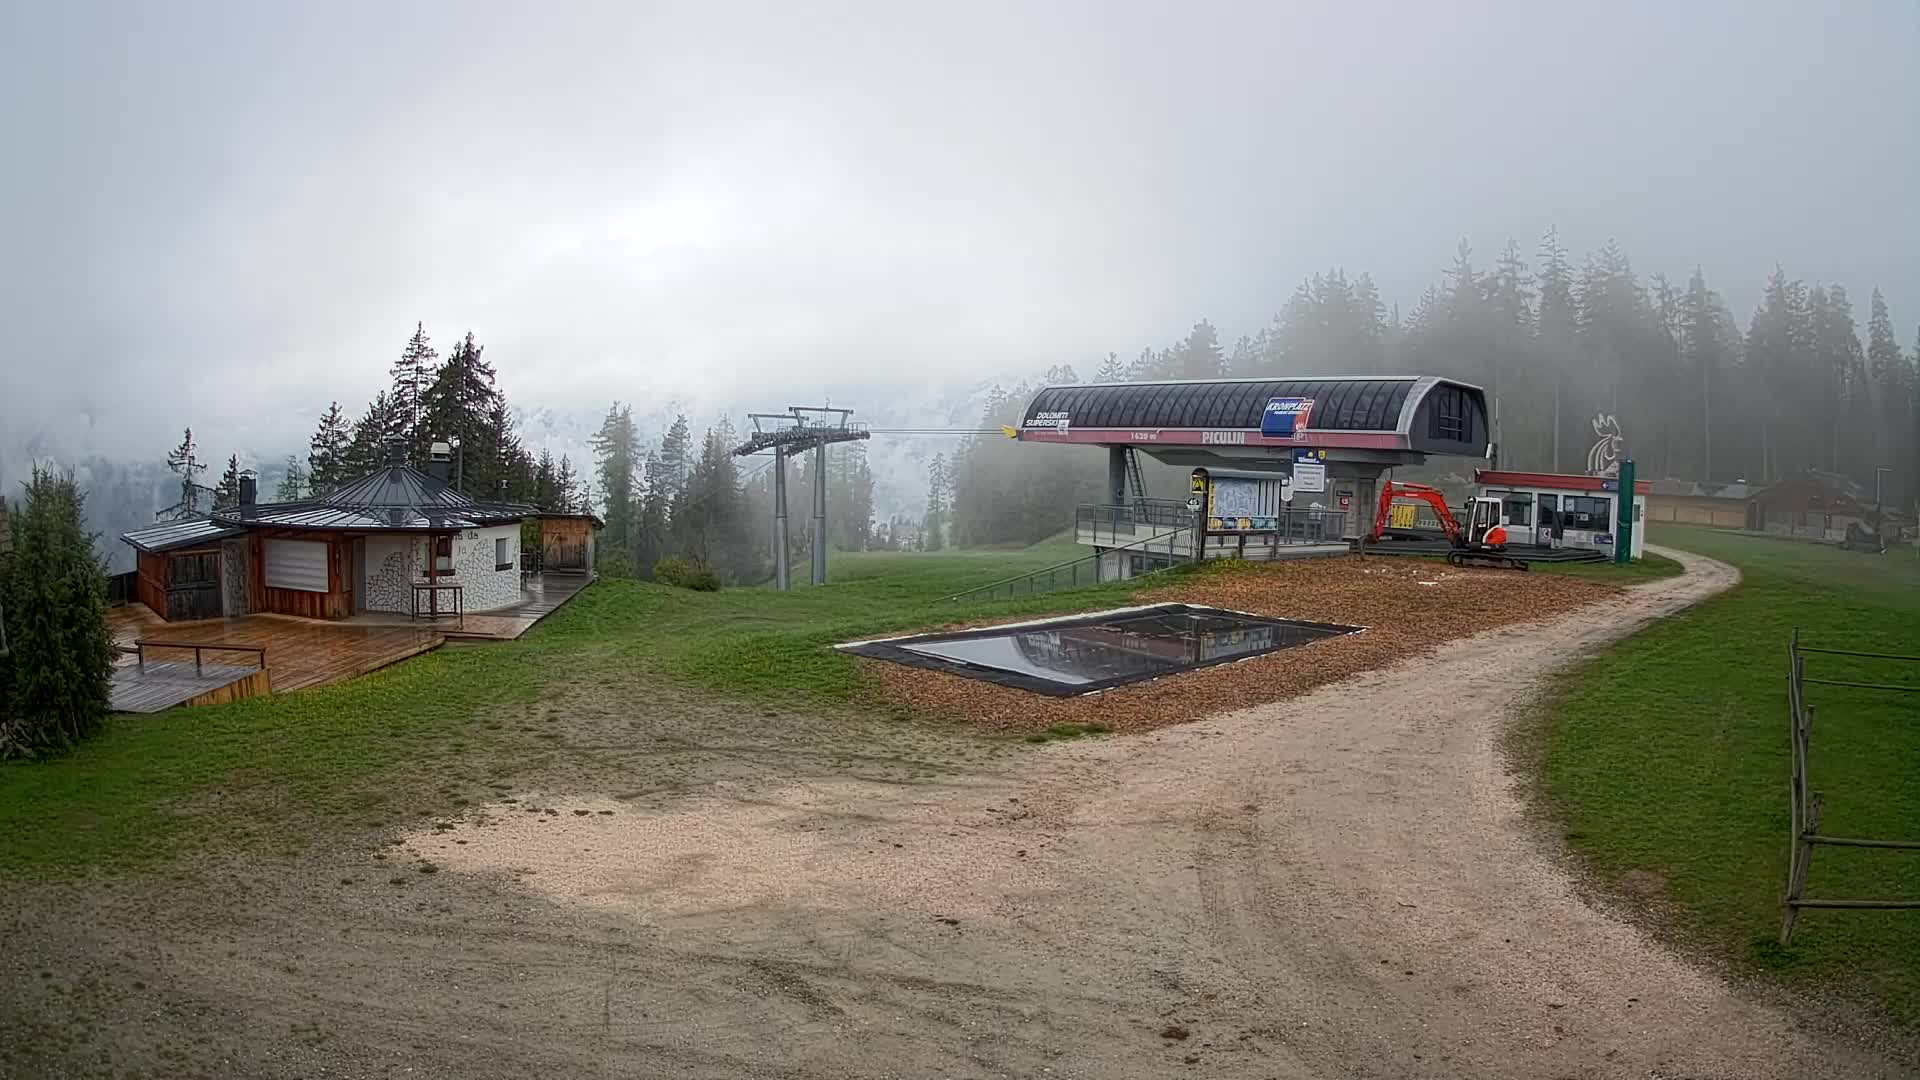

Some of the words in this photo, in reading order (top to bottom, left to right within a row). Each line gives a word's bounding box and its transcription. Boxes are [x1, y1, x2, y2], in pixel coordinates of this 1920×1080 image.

[1266, 402, 1312, 411] KRONPLATZ
[1026, 419, 1058, 427] SUPERSKI
[1202, 432, 1245, 444] PICULIN
